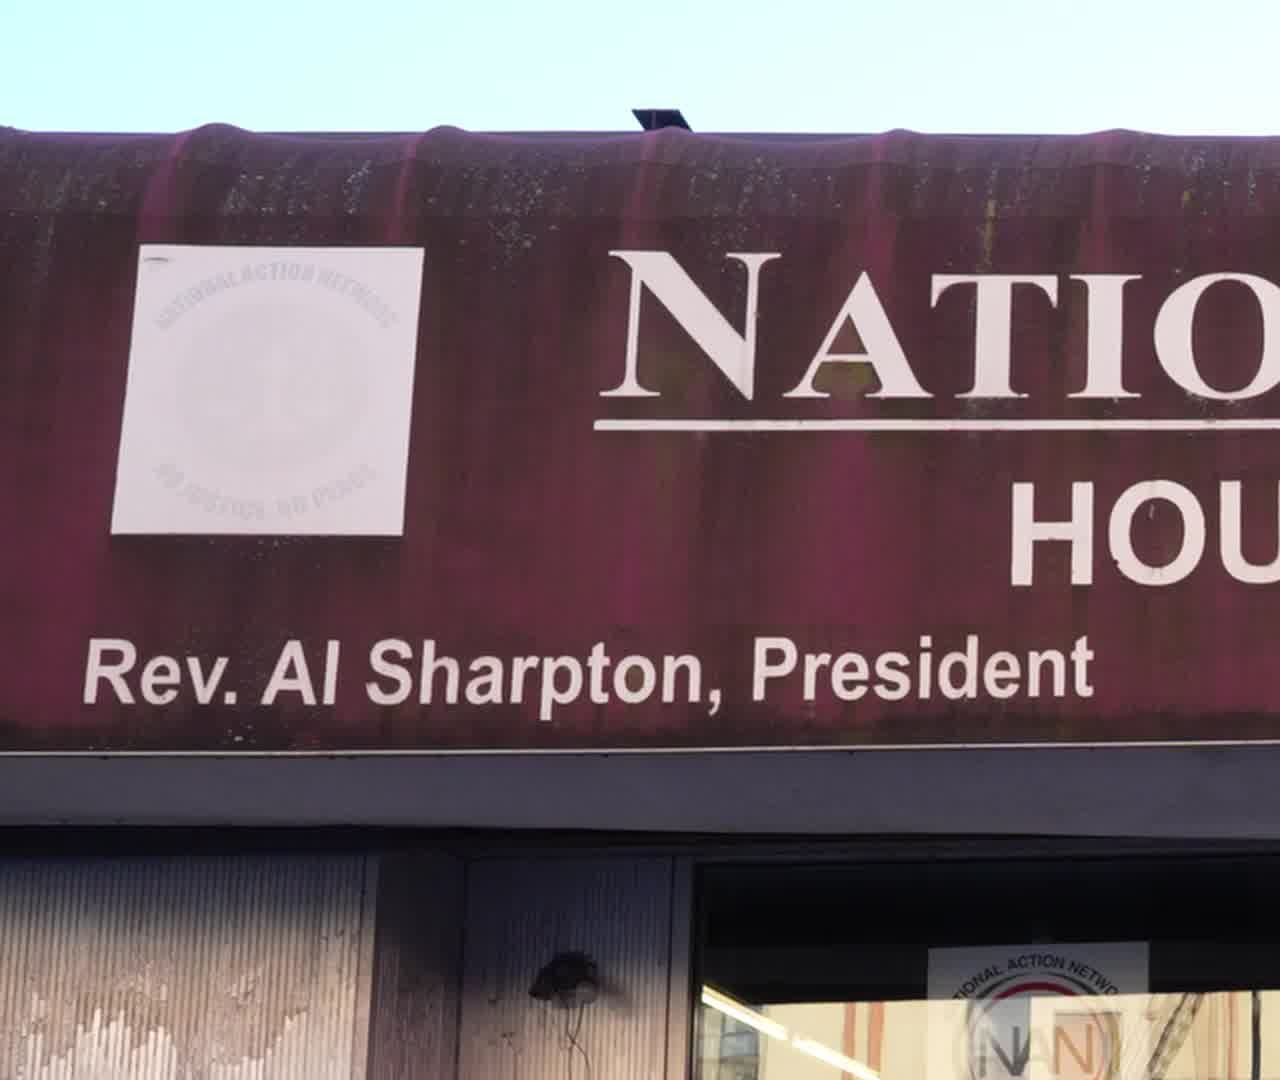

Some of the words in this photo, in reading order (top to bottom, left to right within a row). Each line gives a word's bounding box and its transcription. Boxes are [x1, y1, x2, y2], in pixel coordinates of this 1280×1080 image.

[83, 637, 237, 705] Rev.
[260, 639, 340, 705] Al
[365, 638, 721, 721] Sharpton,
[752, 634, 1094, 701] President
[953, 964, 1003, 1000] TIONAL
[1007, 953, 1065, 970] ACTION
[1068, 960, 1119, 996] NETWO
